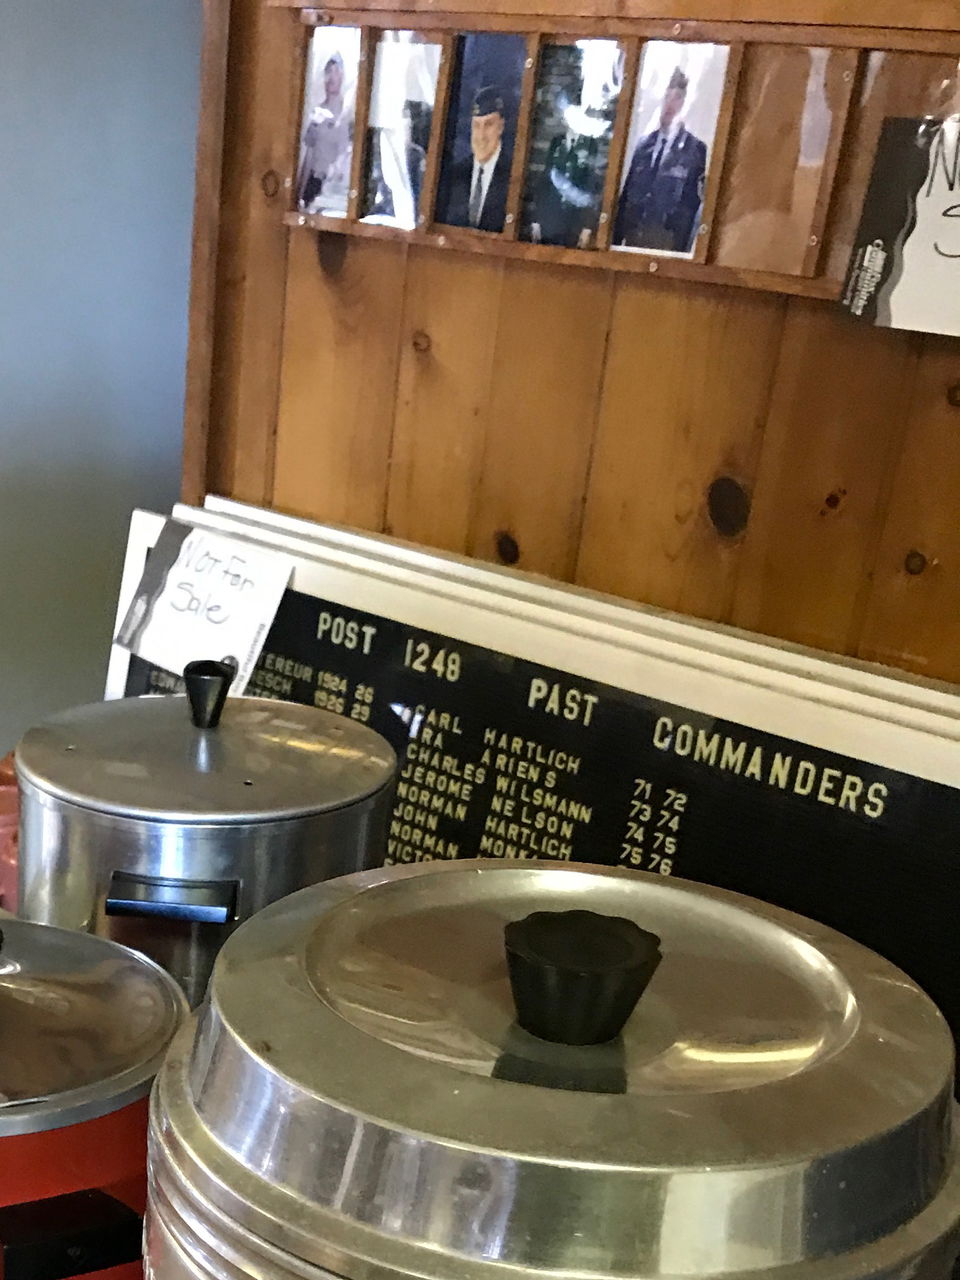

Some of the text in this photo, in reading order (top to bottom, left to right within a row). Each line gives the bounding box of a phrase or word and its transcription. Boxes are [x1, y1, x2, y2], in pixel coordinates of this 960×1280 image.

[170, 582, 231, 624] Sale
[257, 651, 314, 684] EREUR
[317, 612, 889, 819] POST 1248 PAST COMMANDERS
[415, 705, 688, 812] CARL HARTLICH 71 72
[397, 781, 573, 861] NORMAN HARTLICH
[401, 763, 473, 801] JEROME
[620, 843, 643, 865] 75
[648, 853, 672, 876] 76
[407, 743, 676, 855] CHARLES WILSMANN 74 75
[409, 722, 444, 750] RA
[629, 800, 652, 822] 73
[657, 810, 680, 832] 74
[390, 820, 459, 859] NORMAN
[394, 802, 538, 860] JOHN MONK
